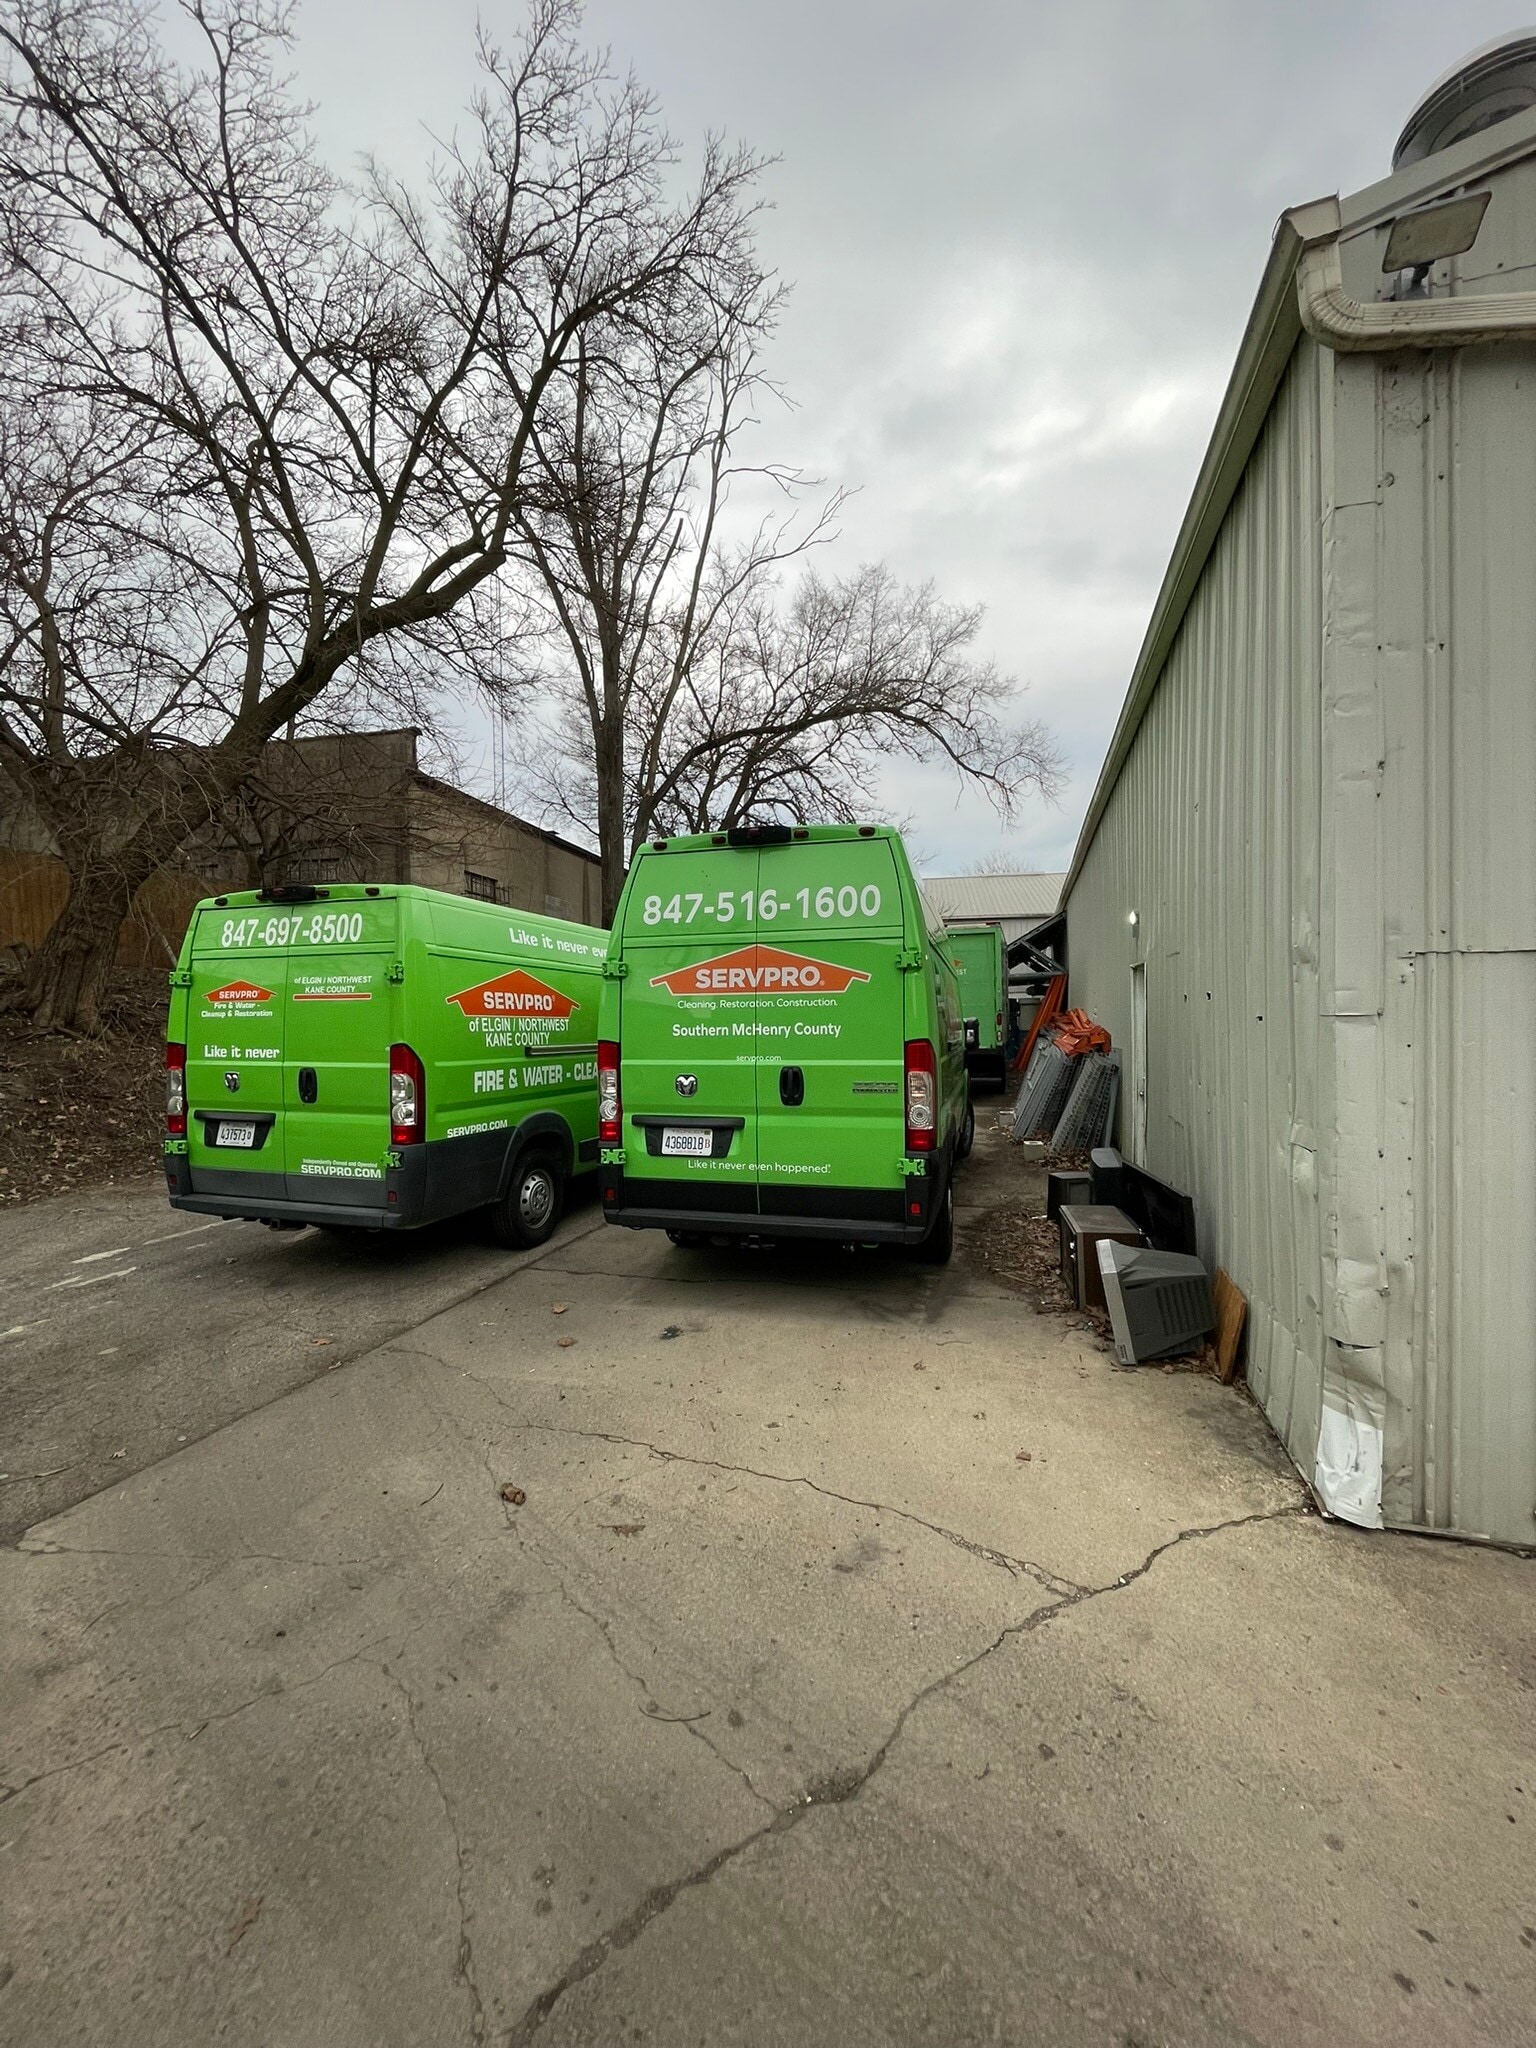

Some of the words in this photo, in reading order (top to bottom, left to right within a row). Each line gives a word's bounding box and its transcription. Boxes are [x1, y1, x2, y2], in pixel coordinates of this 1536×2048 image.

[643, 884, 881, 925] 847-516-1600
[221, 913, 362, 947] 847-697-8500
[509, 927, 538, 946] Like
[541, 934, 553, 949] it
[556, 940, 588, 954] never
[301, 976, 322, 984] ELGIN
[327, 975, 372, 984] NORTHWEST
[219, 990, 258, 999] SERVPRO
[326, 985, 355, 993] COUNTY
[483, 991, 553, 1011] SERVPRO
[776, 998, 838, 1007] Construction.
[201, 1010, 226, 1018] Cleanup
[469, 1017, 479, 1032] of
[481, 1018, 511, 1032] ELGIN
[519, 1018, 569, 1031] NORTHWEST
[672, 1023, 728, 1037] Southern
[732, 1023, 791, 1038] McHenry
[794, 1022, 841, 1038] County
[486, 1032, 512, 1047] KANE
[514, 1032, 550, 1046] COUNTY
[204, 1045, 227, 1057] Like
[231, 1045, 241, 1058] it
[245, 1048, 280, 1058] never
[736, 1054, 782, 1063] servpro.com
[474, 1069, 504, 1093] FIRE
[508, 1068, 518, 1089] &
[522, 1065, 563, 1087] WATER
[447, 1119, 508, 1138] SERVPRO.COM
[301, 1164, 382, 1179] SERVPRO.COM
[688, 1160, 707, 1169] Like
[710, 1160, 716, 1169] it
[718, 1162, 746, 1170] never
[748, 1163, 773, 1171] even
